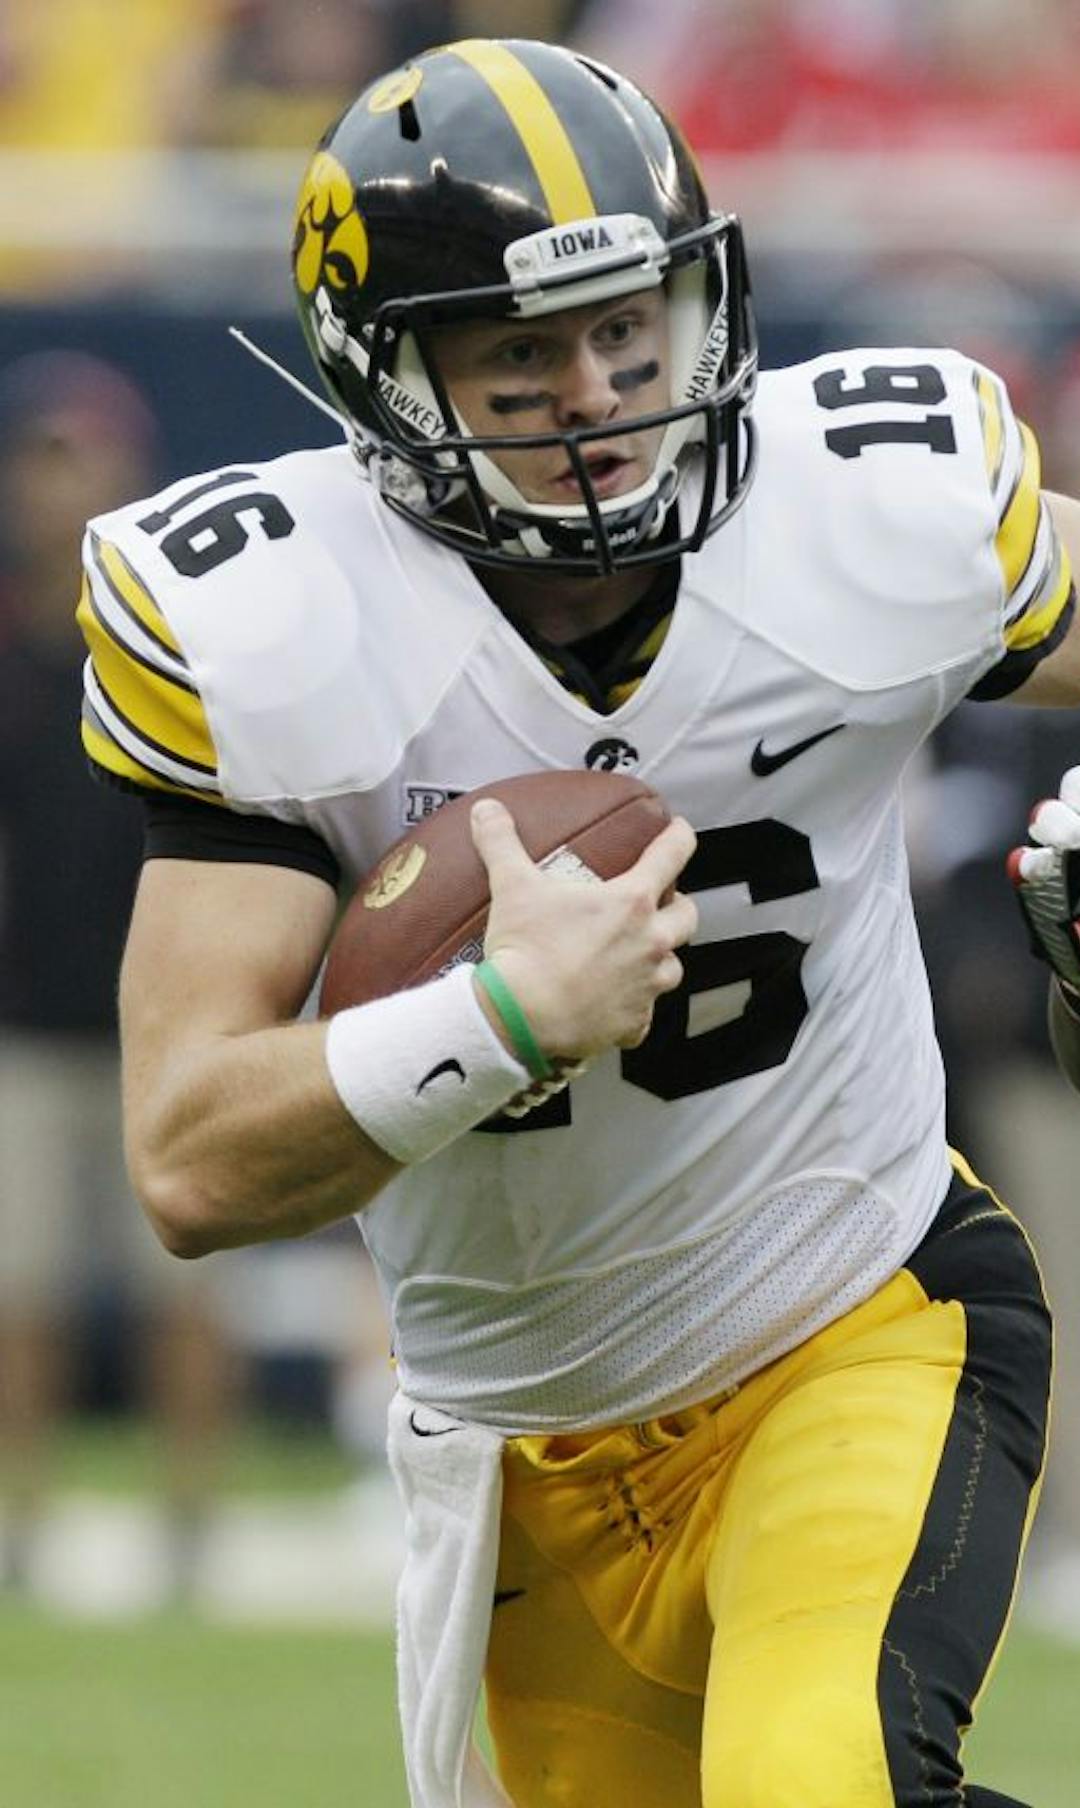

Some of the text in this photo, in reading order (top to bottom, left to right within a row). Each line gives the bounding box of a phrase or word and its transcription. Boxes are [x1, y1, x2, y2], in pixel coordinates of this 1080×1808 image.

[550, 225, 614, 259] IOWA
[812, 364, 958, 460] 16
[135, 472, 296, 579] 16
